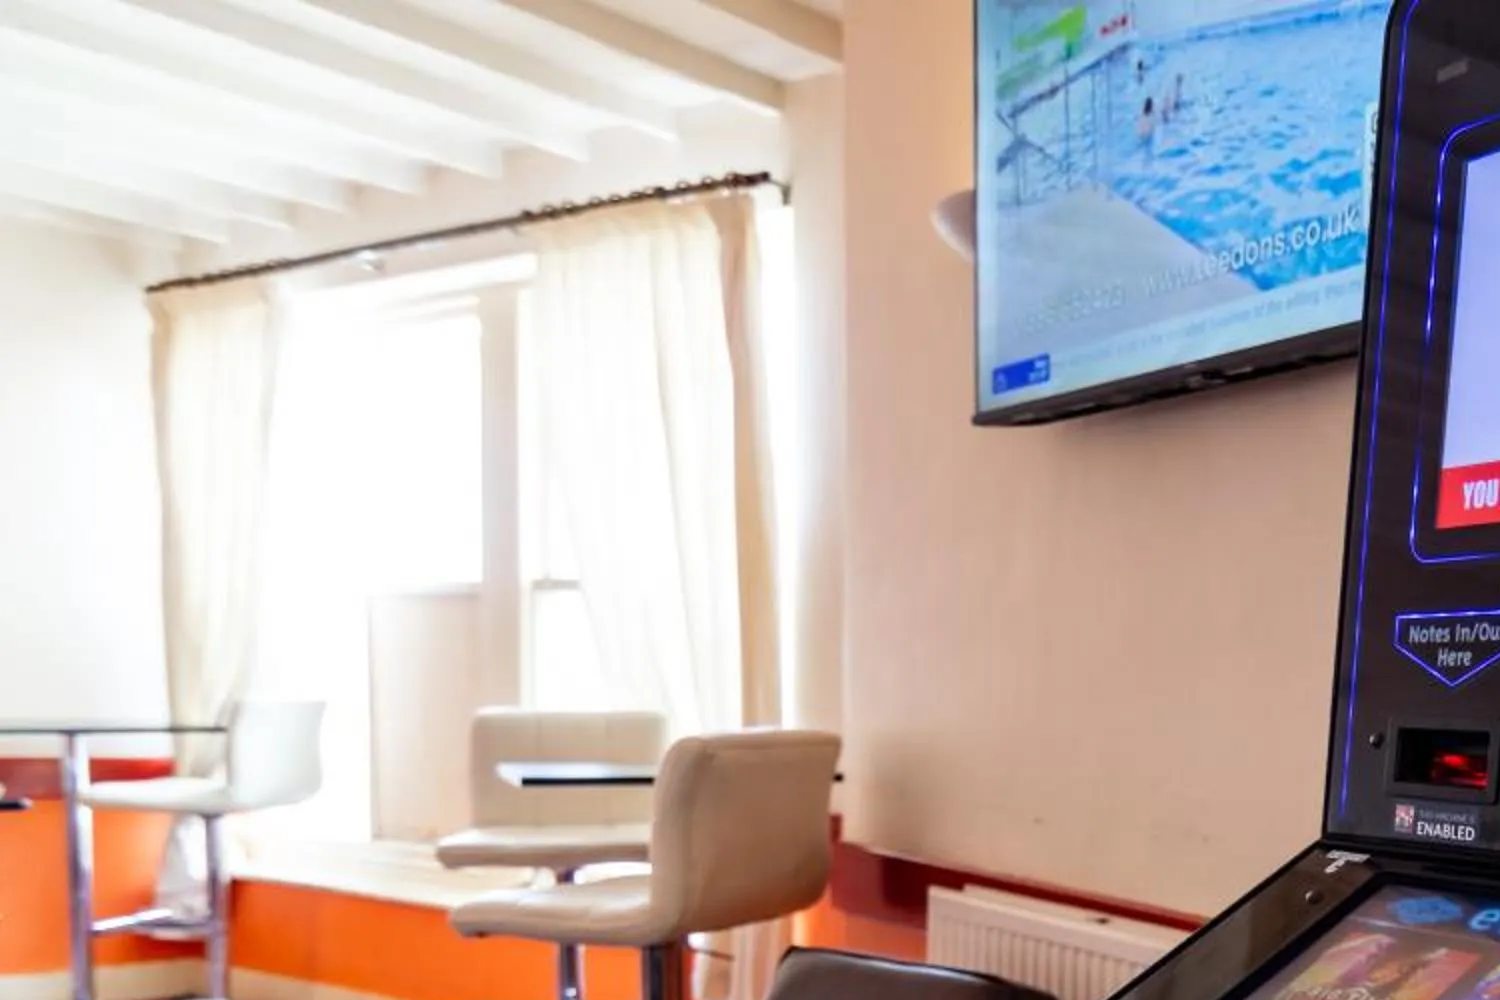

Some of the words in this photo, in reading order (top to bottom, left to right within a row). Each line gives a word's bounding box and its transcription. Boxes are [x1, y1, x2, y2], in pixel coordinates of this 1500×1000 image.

[1463, 478, 1499, 509] YOU
[1409, 624, 1450, 643] Notes
[1437, 648, 1472, 667] Here
[1416, 821, 1475, 841] ENABLED
